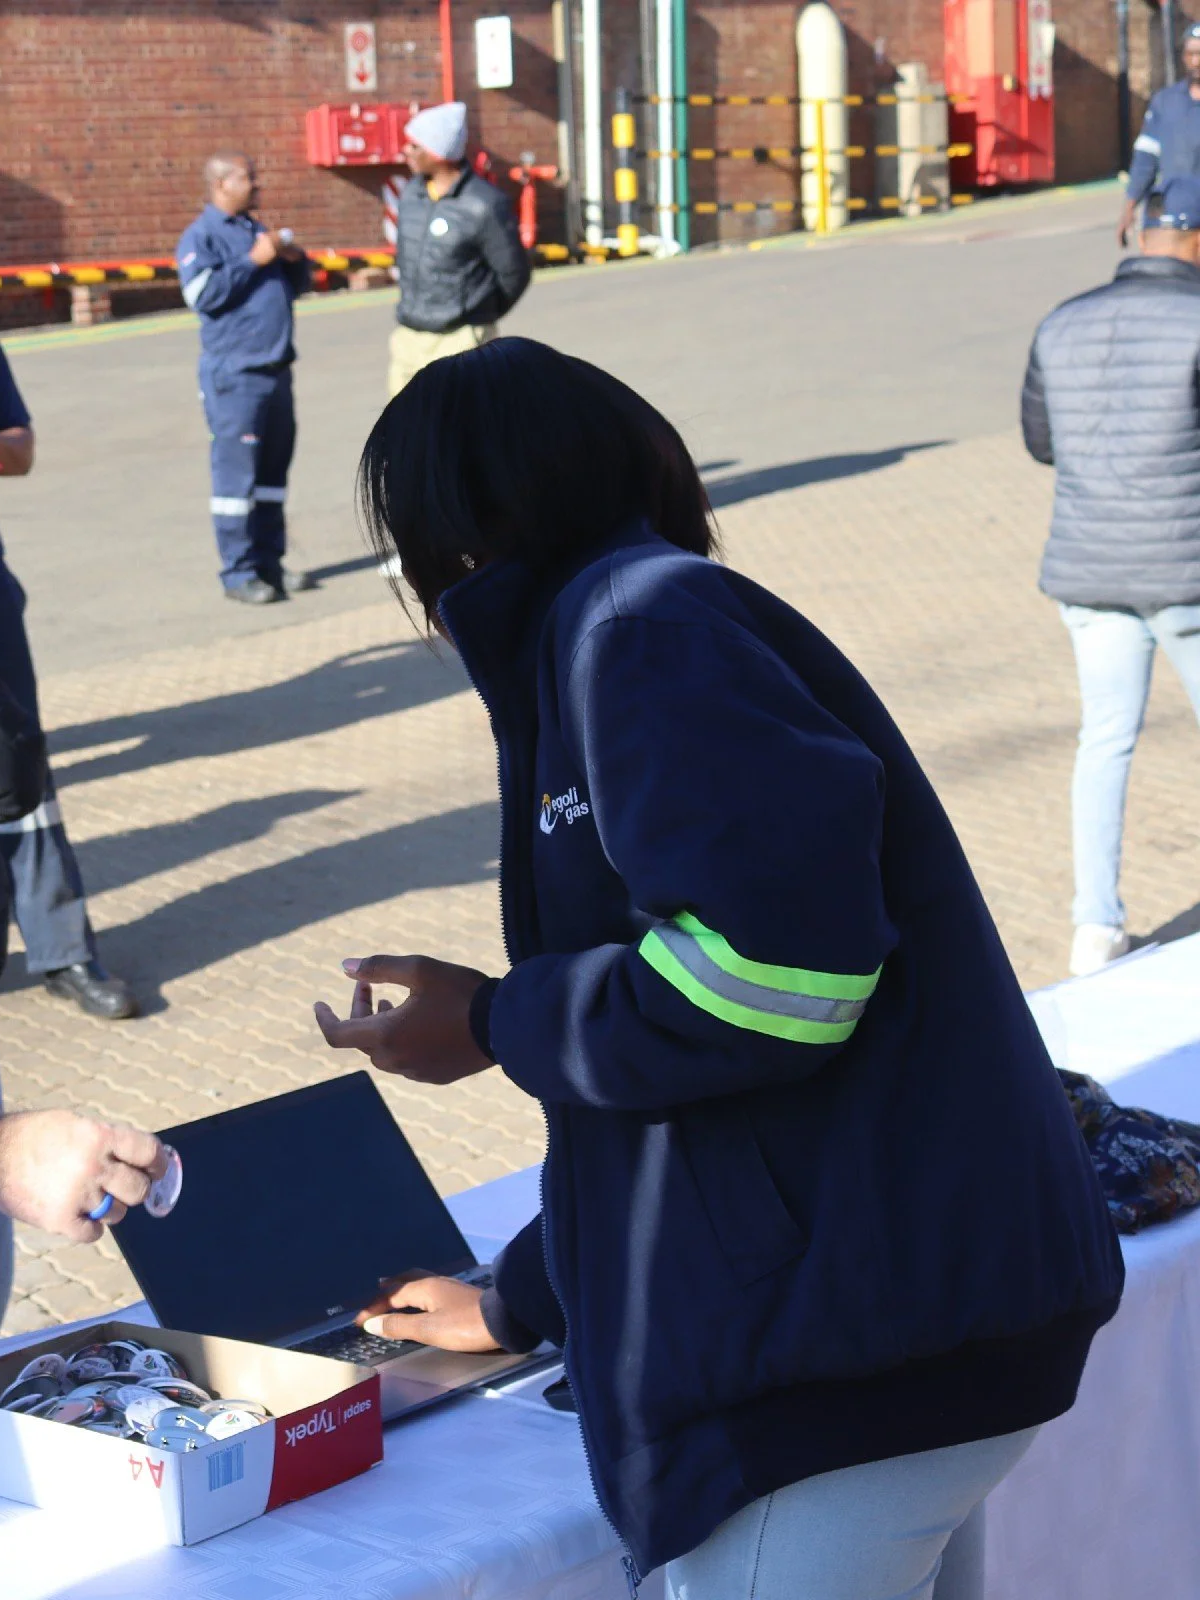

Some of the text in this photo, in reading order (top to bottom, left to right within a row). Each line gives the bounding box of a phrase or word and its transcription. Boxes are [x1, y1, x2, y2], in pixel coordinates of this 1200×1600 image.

[551, 786, 579, 813] egoli
[565, 802, 589, 825] gas
[284, 1399, 372, 1447] sappi Typek
[127, 1453, 165, 1489] A4
